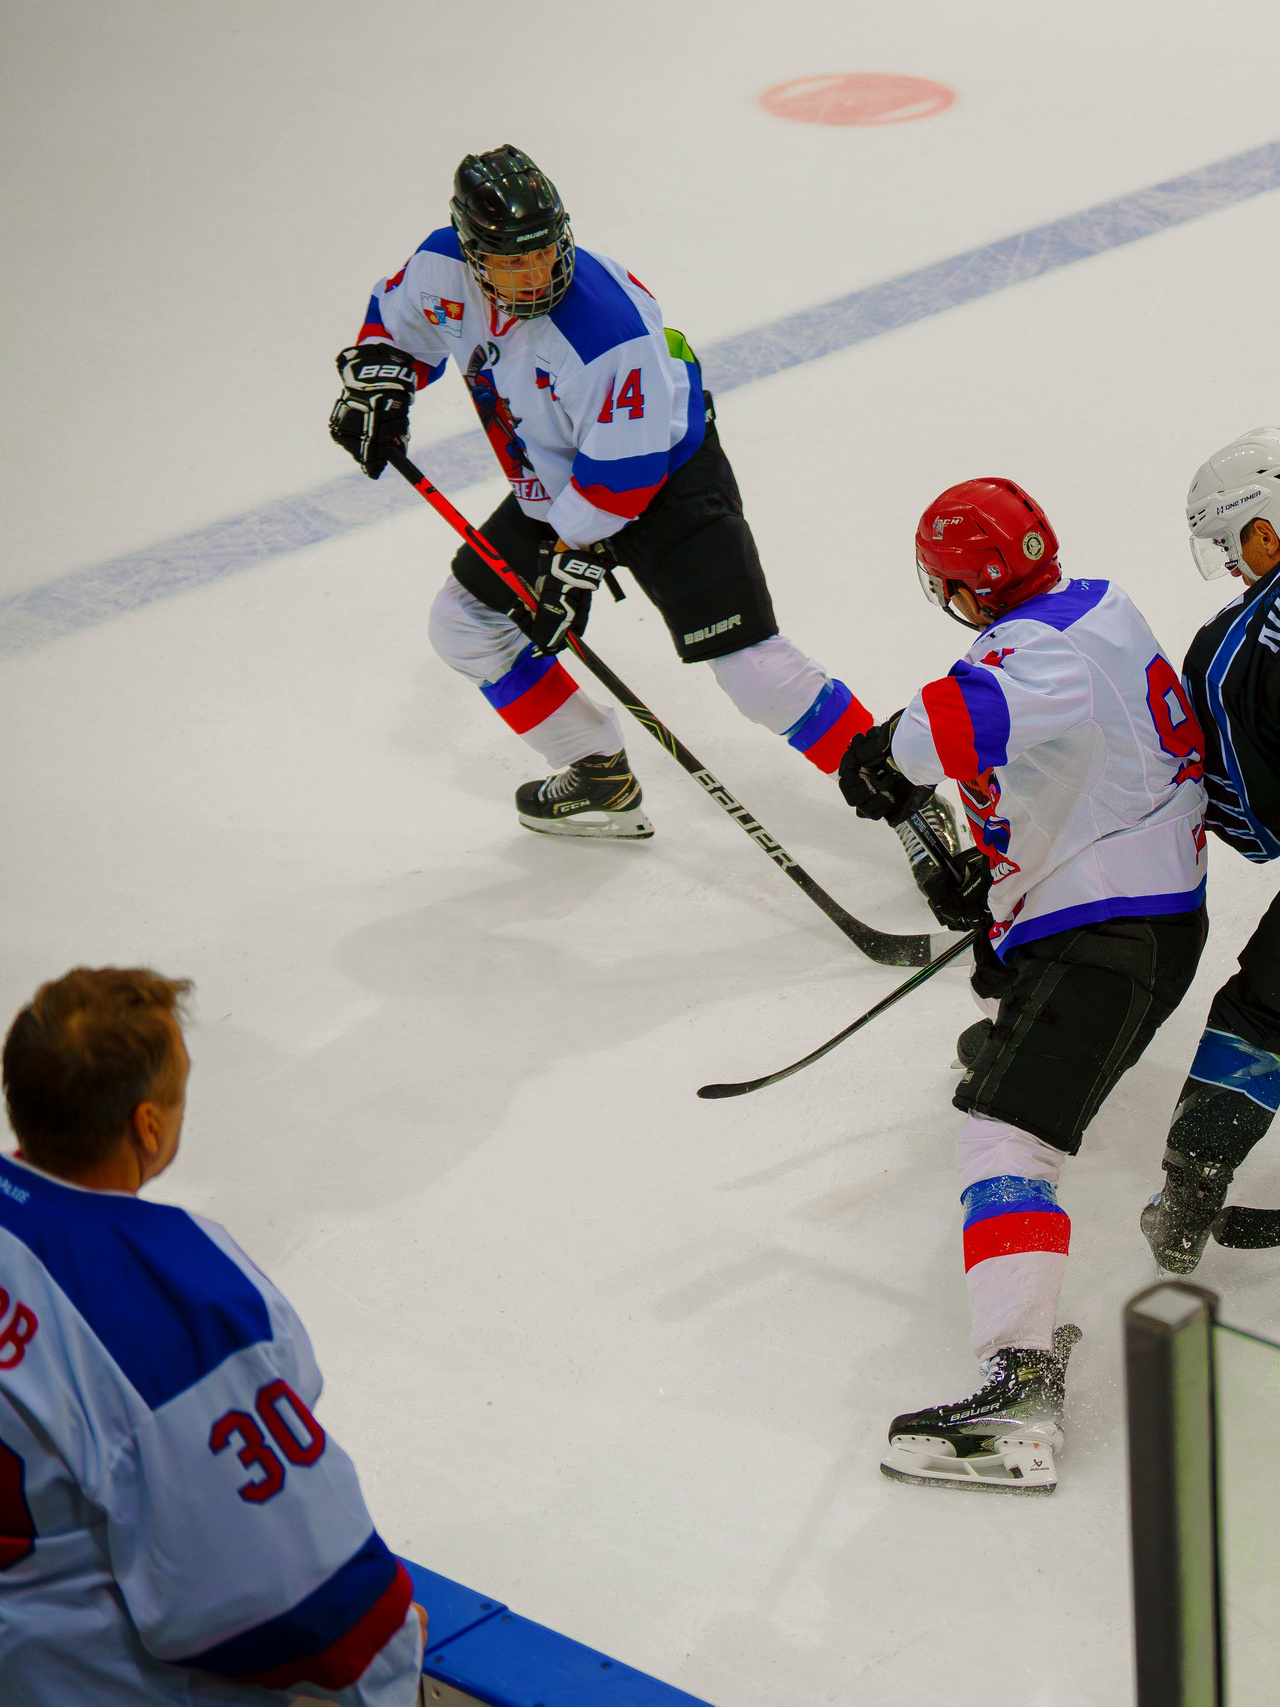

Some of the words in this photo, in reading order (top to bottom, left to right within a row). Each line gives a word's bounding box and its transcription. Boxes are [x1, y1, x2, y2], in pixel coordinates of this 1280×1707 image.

[684, 614, 741, 645] BAUER
[560, 800, 591, 813] CCM
[691, 768, 798, 870] BAUER
[950, 1402, 1000, 1421] BAUER
[208, 1377, 326, 1506] 30
